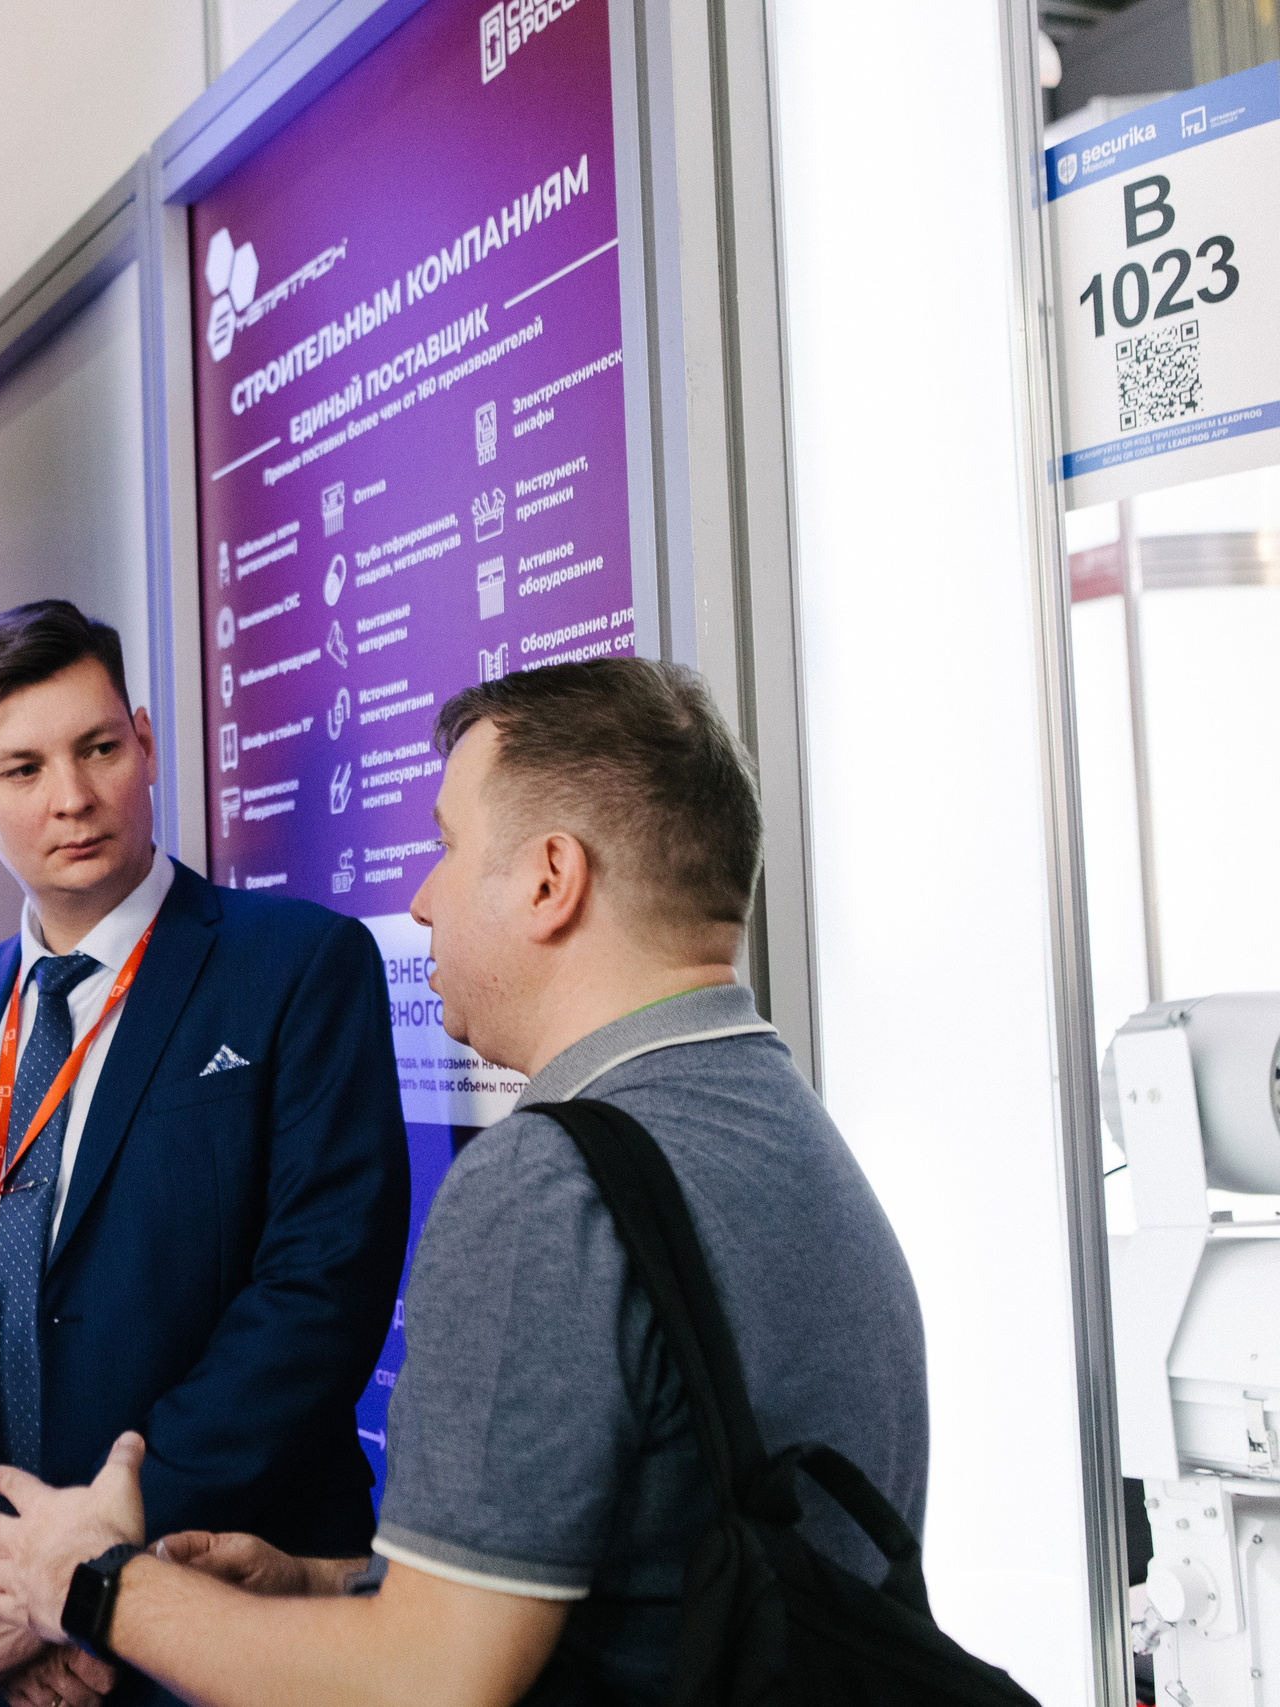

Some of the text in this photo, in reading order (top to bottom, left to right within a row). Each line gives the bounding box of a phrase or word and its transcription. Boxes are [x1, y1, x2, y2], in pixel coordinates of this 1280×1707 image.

[1081, 123, 1157, 165] securika
[1124, 175, 1176, 249] B
[230, 155, 590, 415] СТРОИТЕЛЬНЫМ КОМПАНИЯМ
[1080, 235, 1240, 338] 1023
[289, 303, 490, 445] ЕДИНЫЙ ПОСТАВЩИК
[302, 430, 347, 466] поставки
[347, 412, 379, 441] более
[380, 398, 402, 421] чем
[403, 390, 417, 410] от
[417, 376, 437, 401] 160
[438, 315, 544, 392] производителей
[513, 406, 555, 439] шкафы
[1217, 408, 1263, 428] LEADFROG
[1168, 432, 1210, 450] LEADFROG
[1211, 427, 1229, 440] APP
[352, 478, 387, 504] Оптика
[515, 454, 589, 498] Инструмент,
[516, 485, 575, 523] протяжки
[355, 512, 459, 569] Труба гофрированная,
[517, 540, 575, 575] Активное
[355, 533, 462, 588] гладкая, металлорукав
[518, 555, 605, 598] оборудование
[356, 603, 411, 635] Монтажные
[520, 606, 635, 655] Оборудование для
[357, 626, 408, 655] материалы
[358, 677, 409, 705] Источники
[359, 691, 435, 726] электропитания
[361, 740, 431, 769] Кабель-каналы
[362, 758, 443, 789] и аксессуары для
[362, 789, 403, 810] монтажа
[364, 866, 404, 884] изделия
[457, 1076, 498, 1094] объемы
